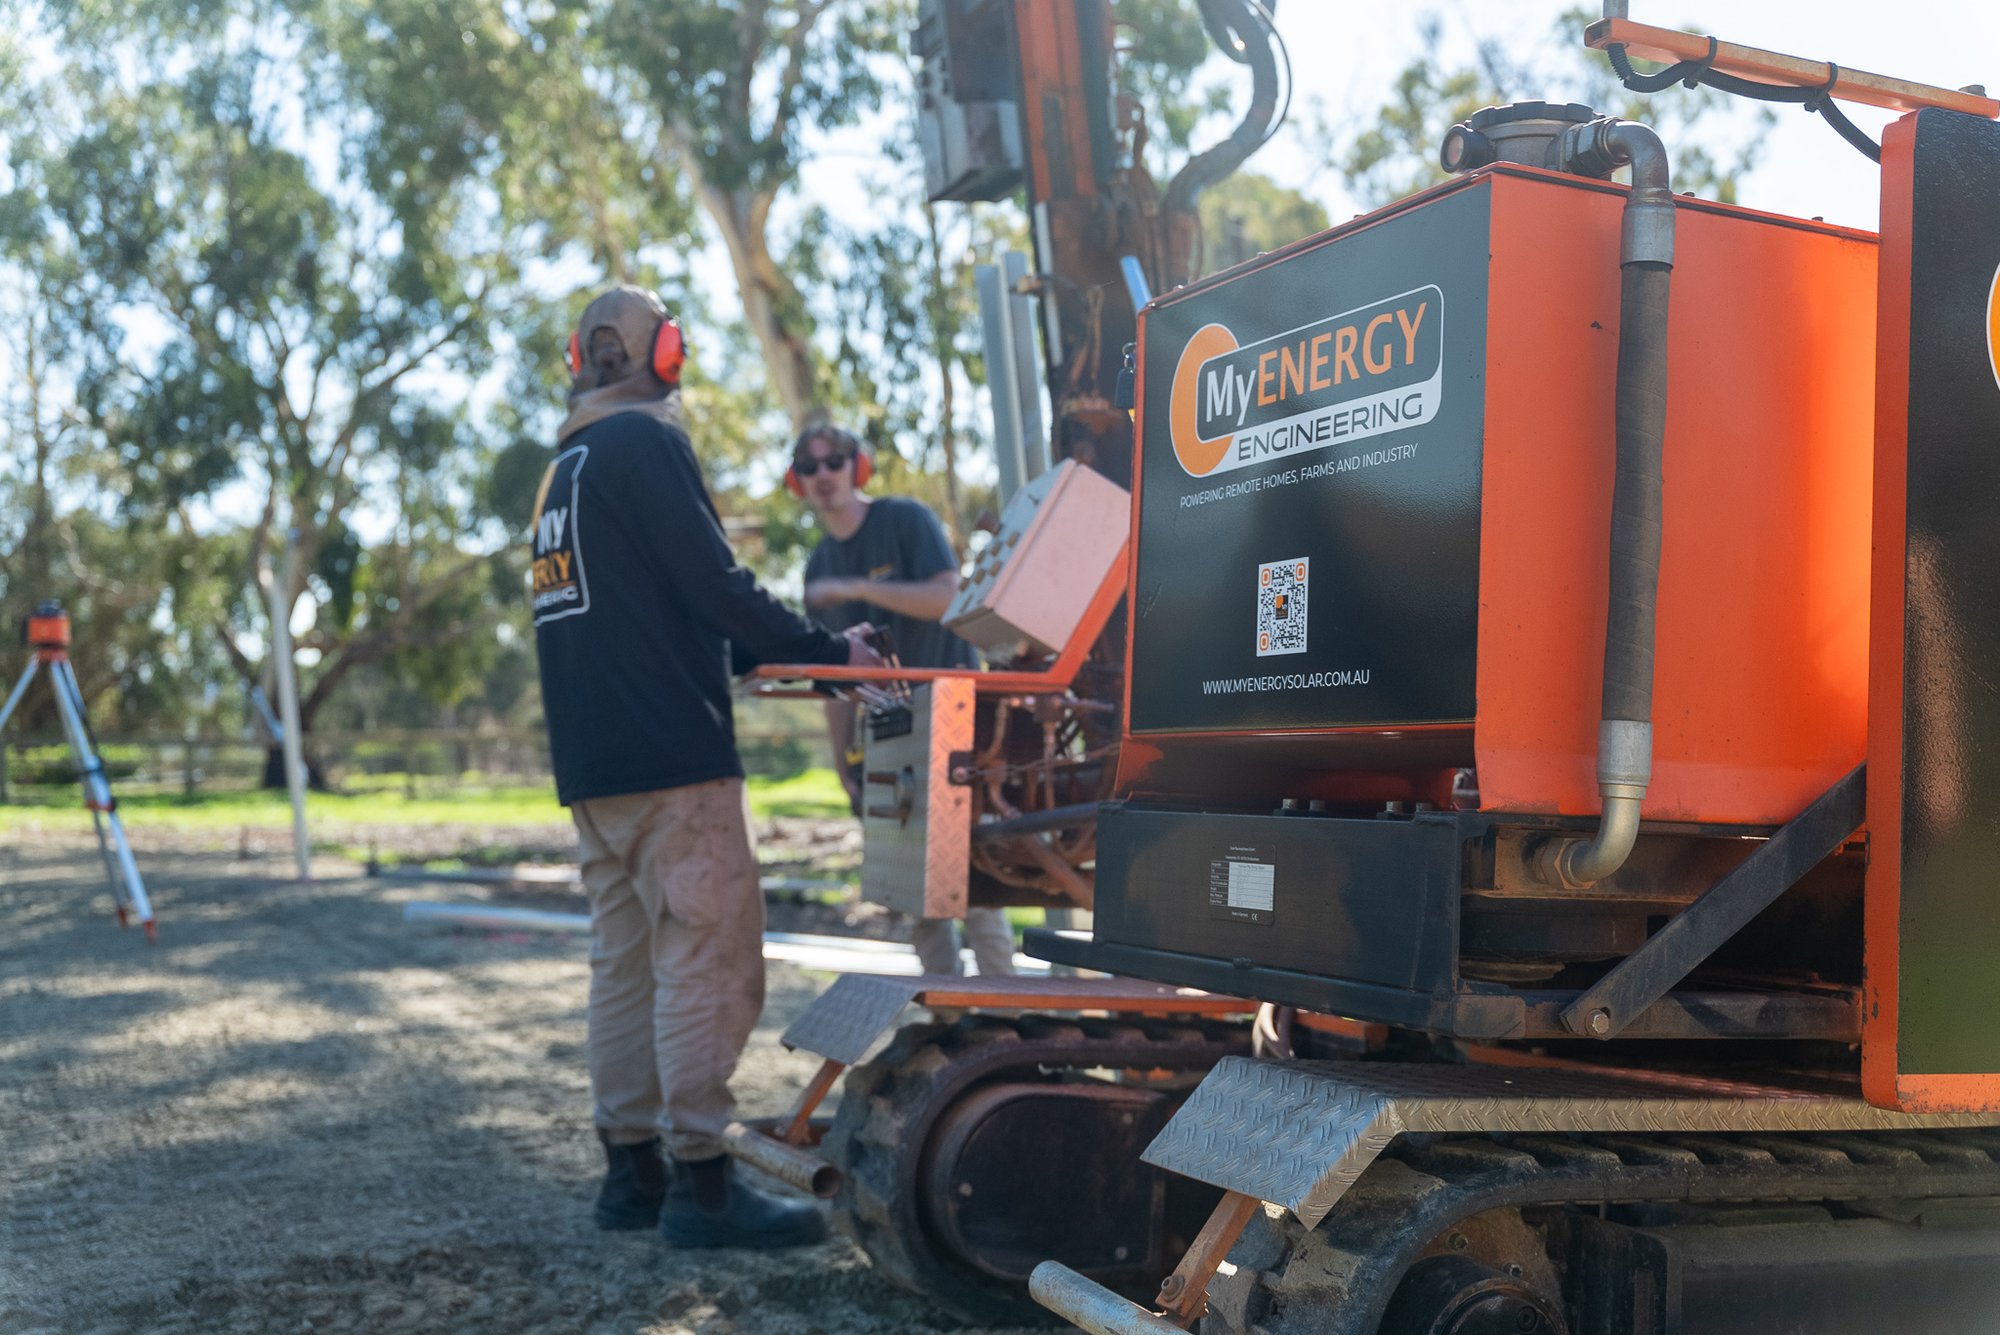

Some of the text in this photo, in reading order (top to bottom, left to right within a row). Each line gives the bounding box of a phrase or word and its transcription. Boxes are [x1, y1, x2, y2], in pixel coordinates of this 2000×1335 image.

[1238, 392, 1423, 461] ENGINEERING
[1180, 443, 1418, 508] POWERING REMOTE HOMES, FARMS AND INDUSTRY
[1203, 669, 1370, 695] WWW.MYENERGYSOLAR.COM.AU
